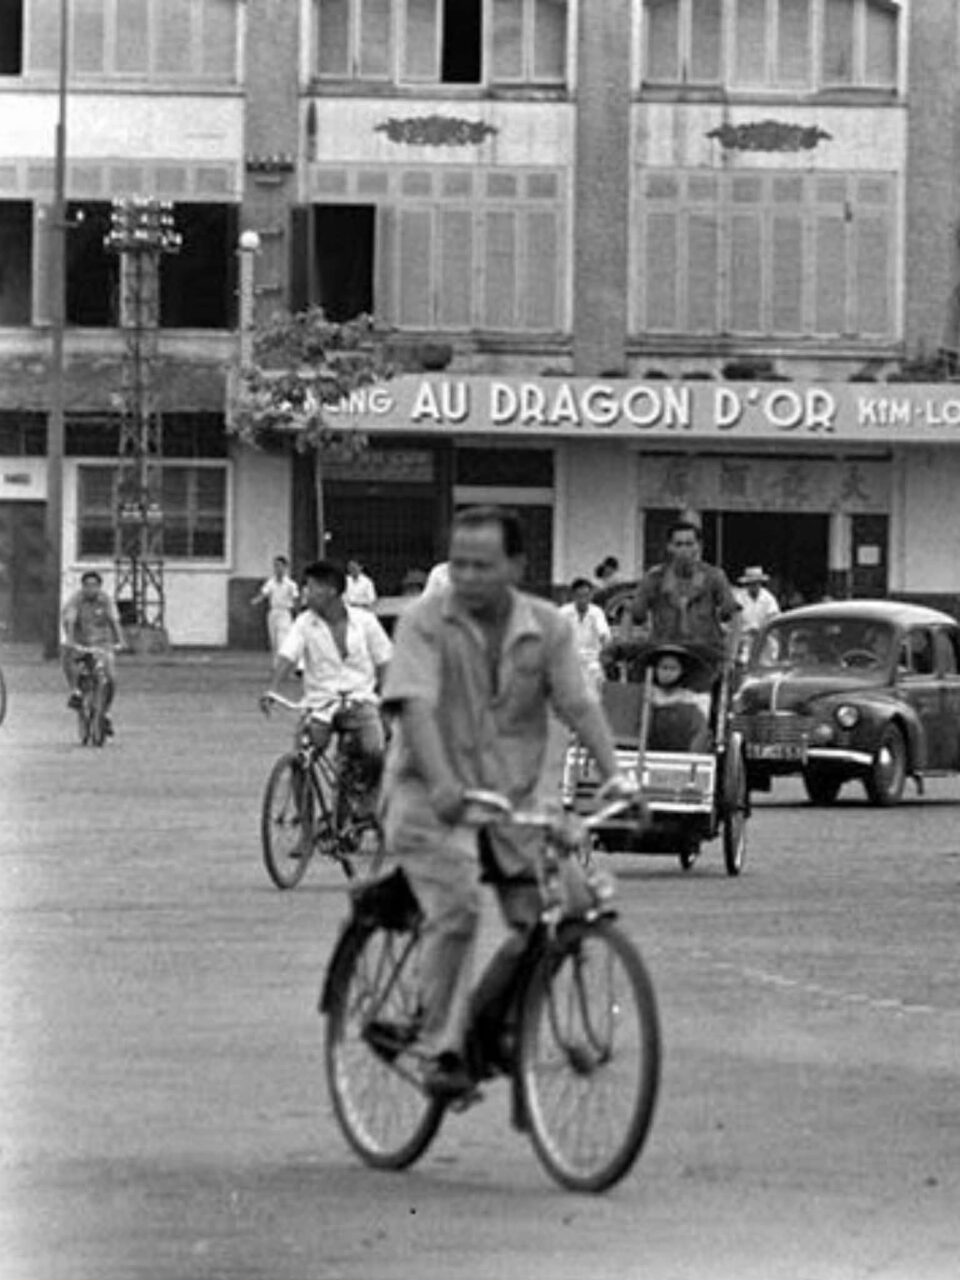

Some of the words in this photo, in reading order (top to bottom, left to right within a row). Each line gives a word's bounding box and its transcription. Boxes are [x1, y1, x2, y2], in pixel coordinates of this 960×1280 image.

[410, 381, 469, 423] AU
[489, 383, 691, 427] DRAGON
[714, 386, 837, 431] D'OR
